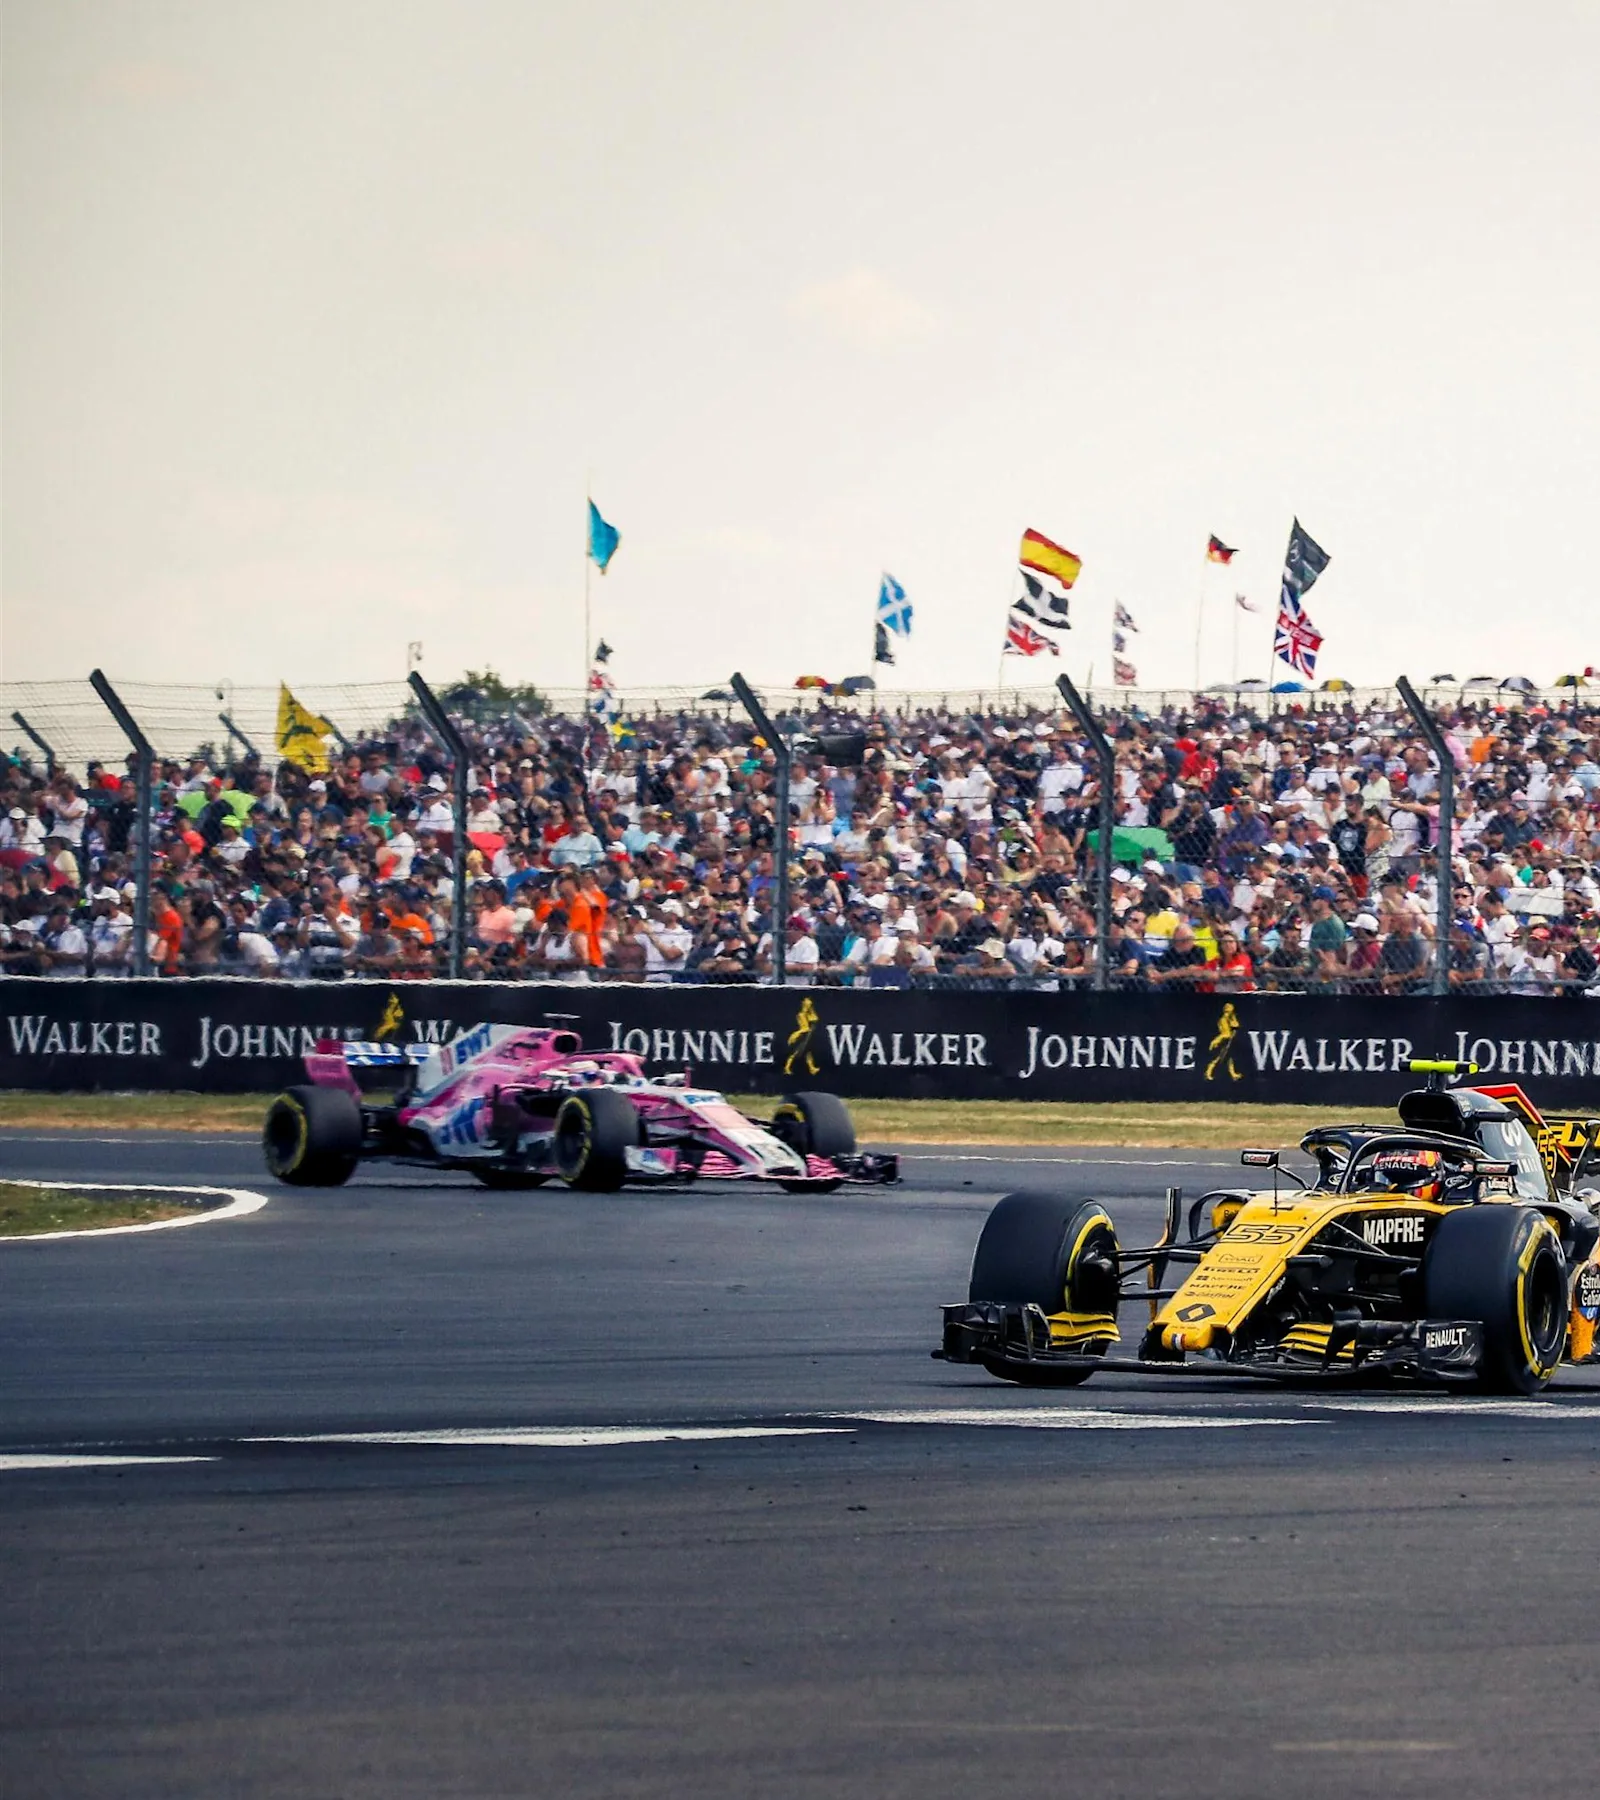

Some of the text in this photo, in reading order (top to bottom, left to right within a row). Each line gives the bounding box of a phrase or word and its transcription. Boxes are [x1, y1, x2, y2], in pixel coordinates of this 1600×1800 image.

[8, 1015, 161, 1055] WALKER
[608, 1021, 987, 1067] JOHNNIE WALKER
[1018, 1026, 1413, 1079] JOHNNIE WALKER
[1219, 1223, 1305, 1246] 55
[1363, 1216, 1425, 1244] MAPFRE
[1425, 1327, 1467, 1348] RENAULT
